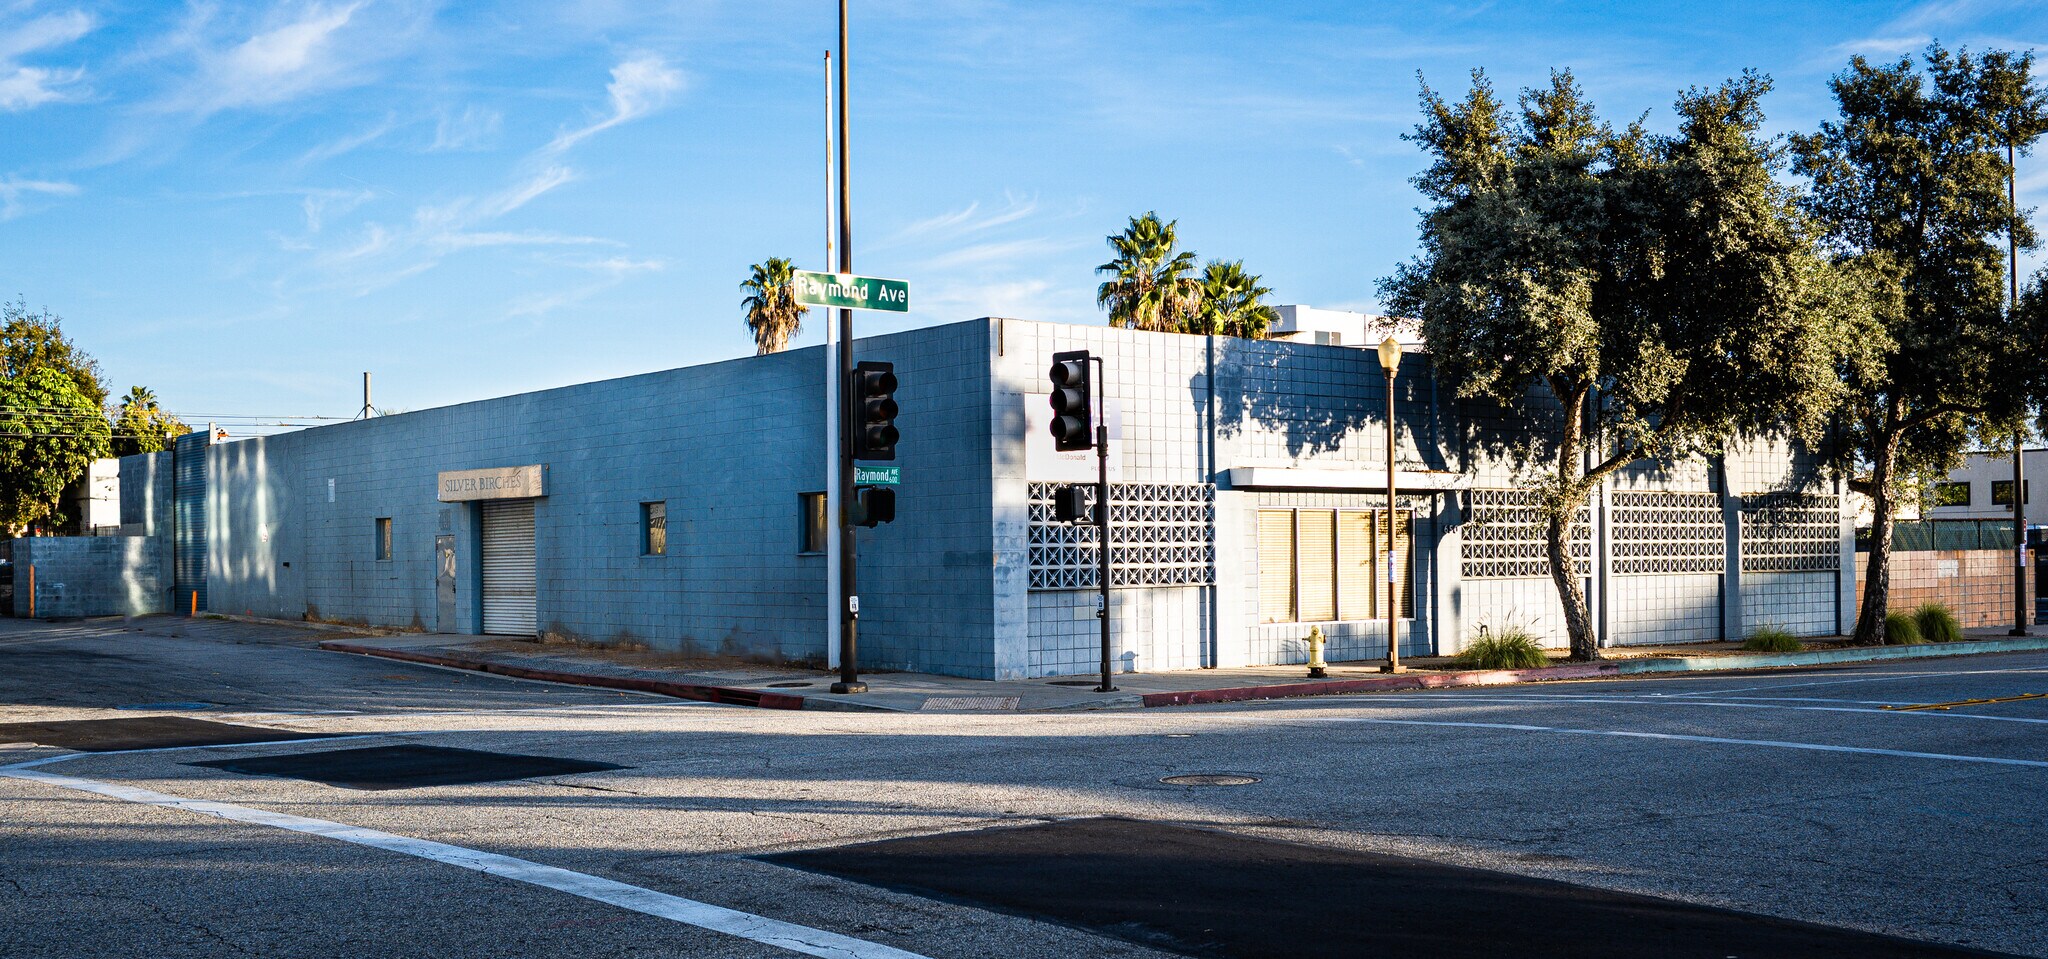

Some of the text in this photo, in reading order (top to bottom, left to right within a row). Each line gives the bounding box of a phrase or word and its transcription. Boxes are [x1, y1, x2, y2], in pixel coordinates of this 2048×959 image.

[799, 276, 906, 303] Raymond Ave
[445, 475, 521, 492] SILVER BIRCHES
[856, 468, 889, 483] Raymond
